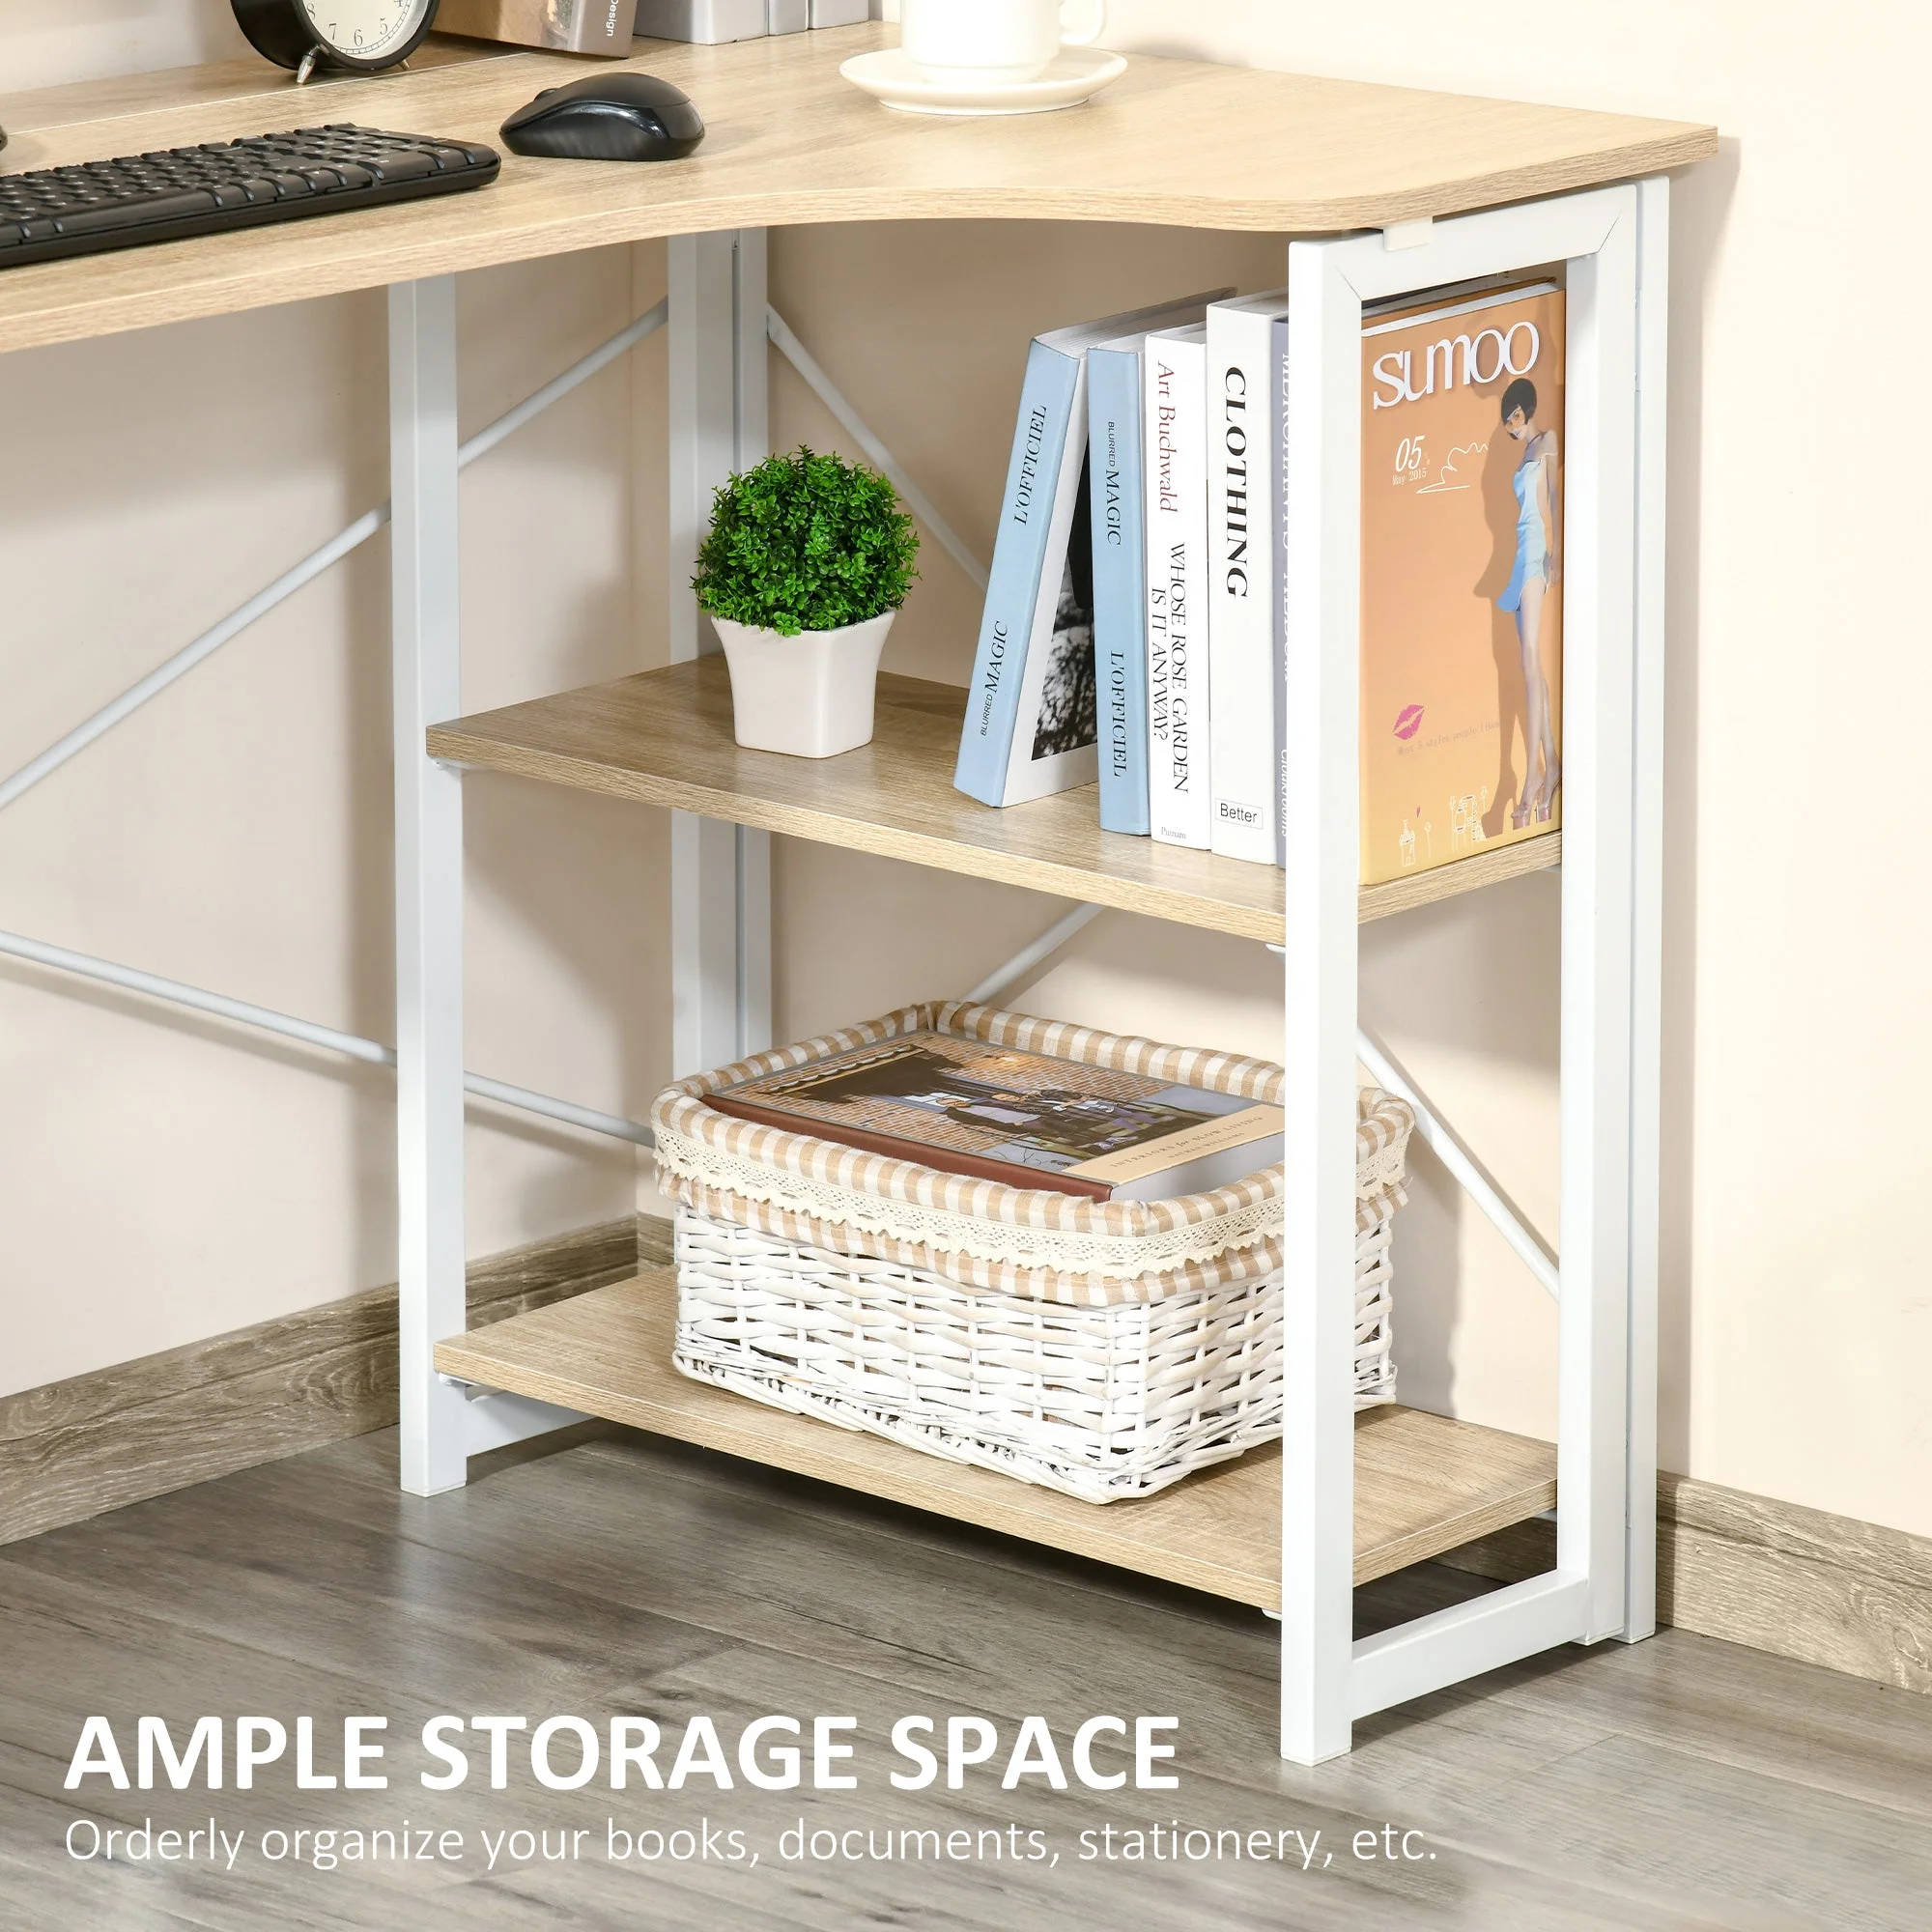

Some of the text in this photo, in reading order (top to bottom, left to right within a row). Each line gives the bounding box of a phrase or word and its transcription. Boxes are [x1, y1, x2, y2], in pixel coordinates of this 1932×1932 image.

[328, 22, 336, 41] 7
[354, 29, 363, 46] 6
[380, 16, 387, 35] 5
[1012, 405, 1048, 526] L'OFFICIEL
[1106, 421, 1122, 546] BLURRED MAGIC
[1157, 360, 1179, 513] Art Buchwald
[1224, 366, 1249, 599] CLOTHING
[1395, 435, 1426, 472] 05
[980, 620, 1009, 737] BLURRED MAGIC
[1110, 650, 1128, 779] L'OFFICIEL
[1151, 587, 1169, 741] IS IT ANYWAY?
[1170, 541, 1189, 793] WHOSE ROSE GARDEN
[1220, 803, 1258, 823] Better
